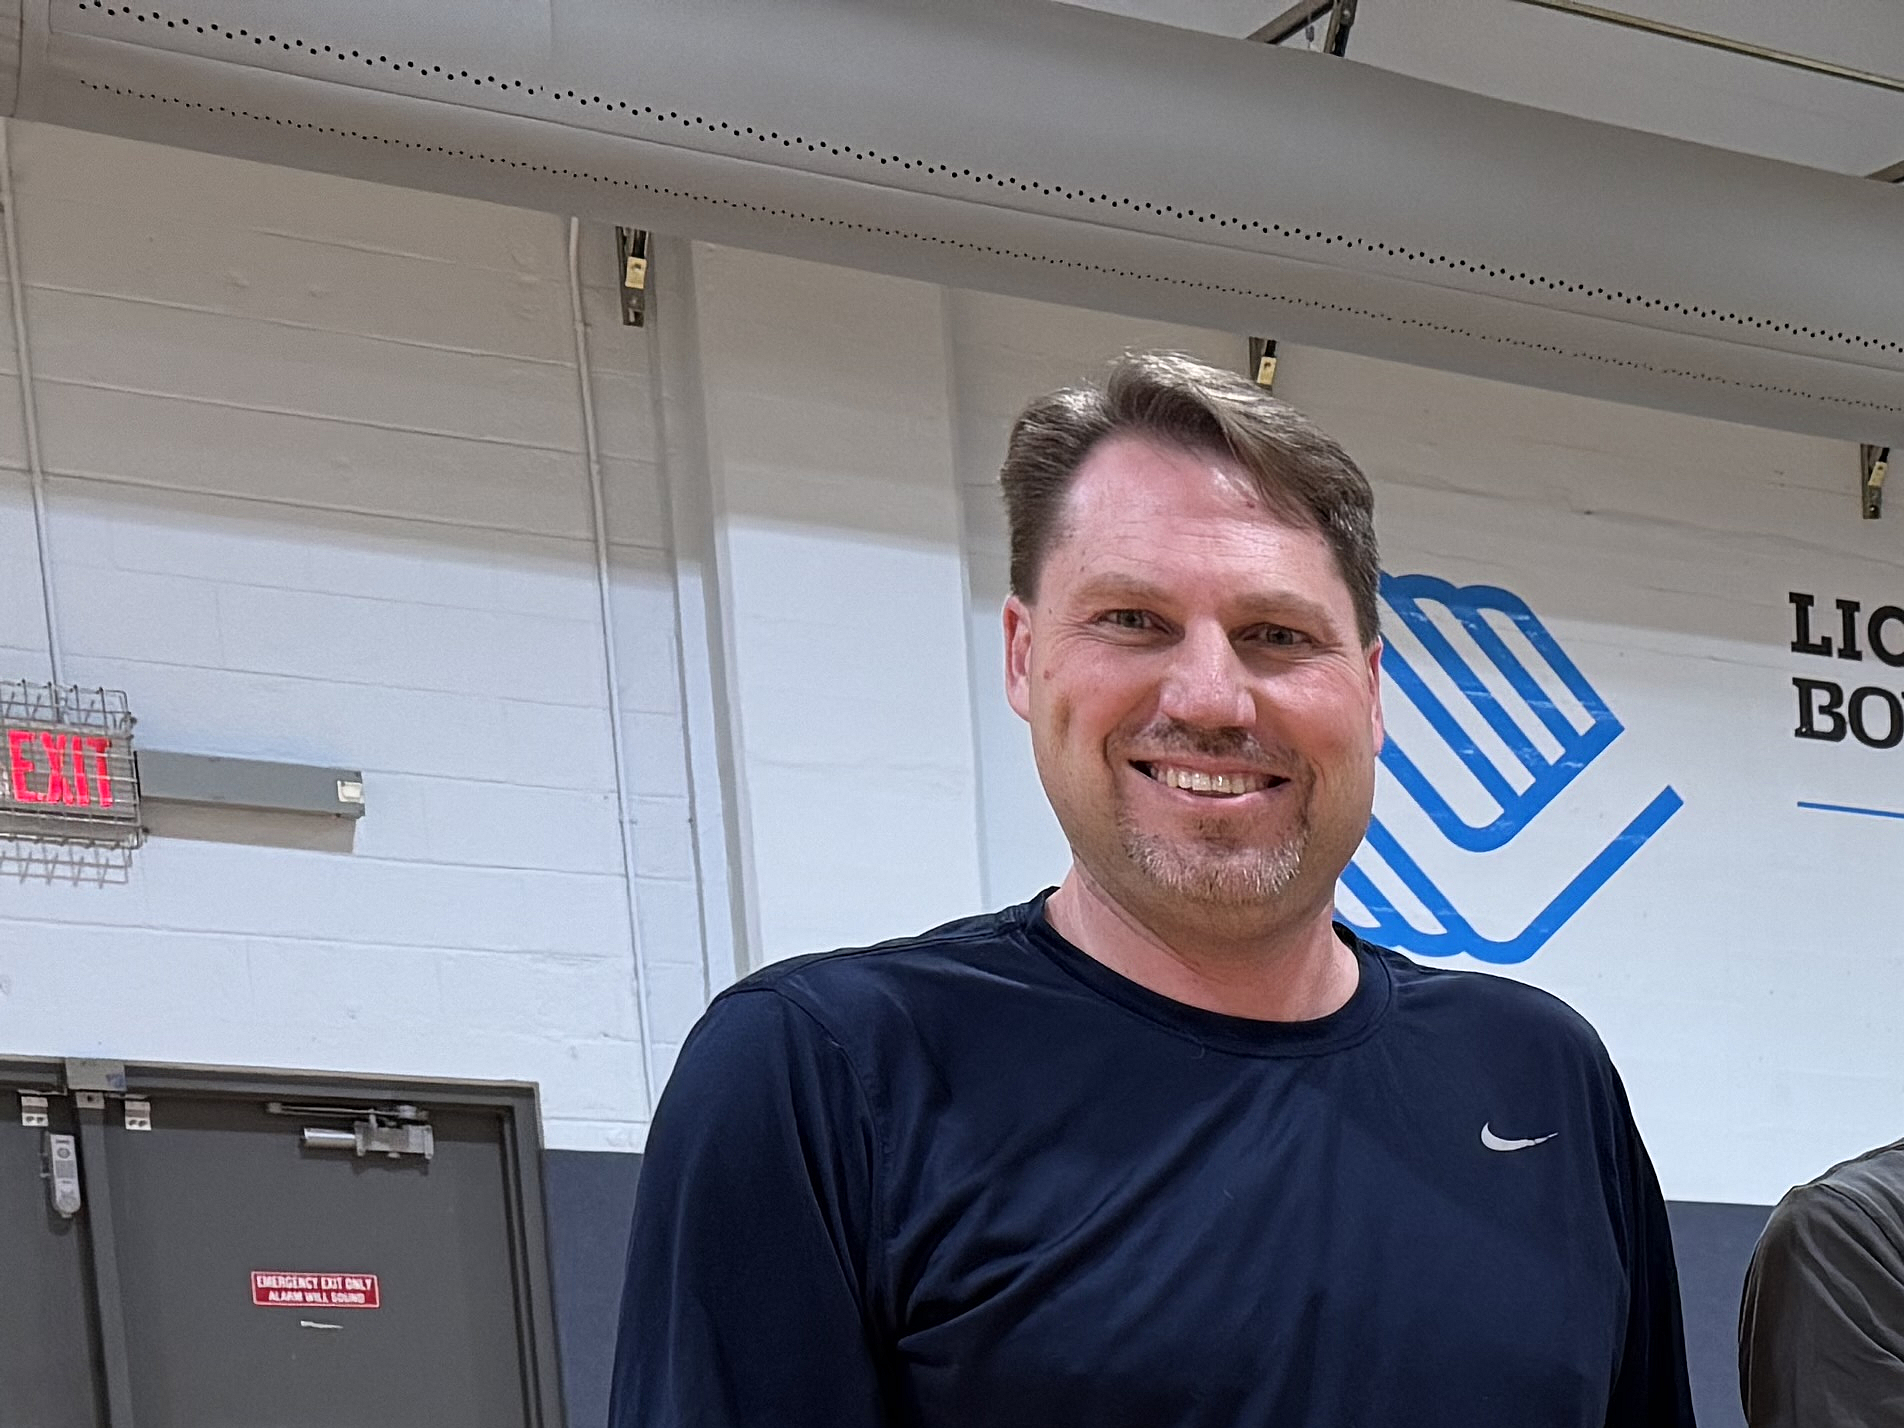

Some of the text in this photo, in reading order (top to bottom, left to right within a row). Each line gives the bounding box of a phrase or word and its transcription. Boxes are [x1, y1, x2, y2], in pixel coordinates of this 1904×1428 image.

[9, 730, 113, 808] EXIT
[256, 1275, 372, 1291] EMERGENCY EXIT ONLY
[268, 1290, 304, 1302] ALARM
[304, 1291, 329, 1303] WILL
